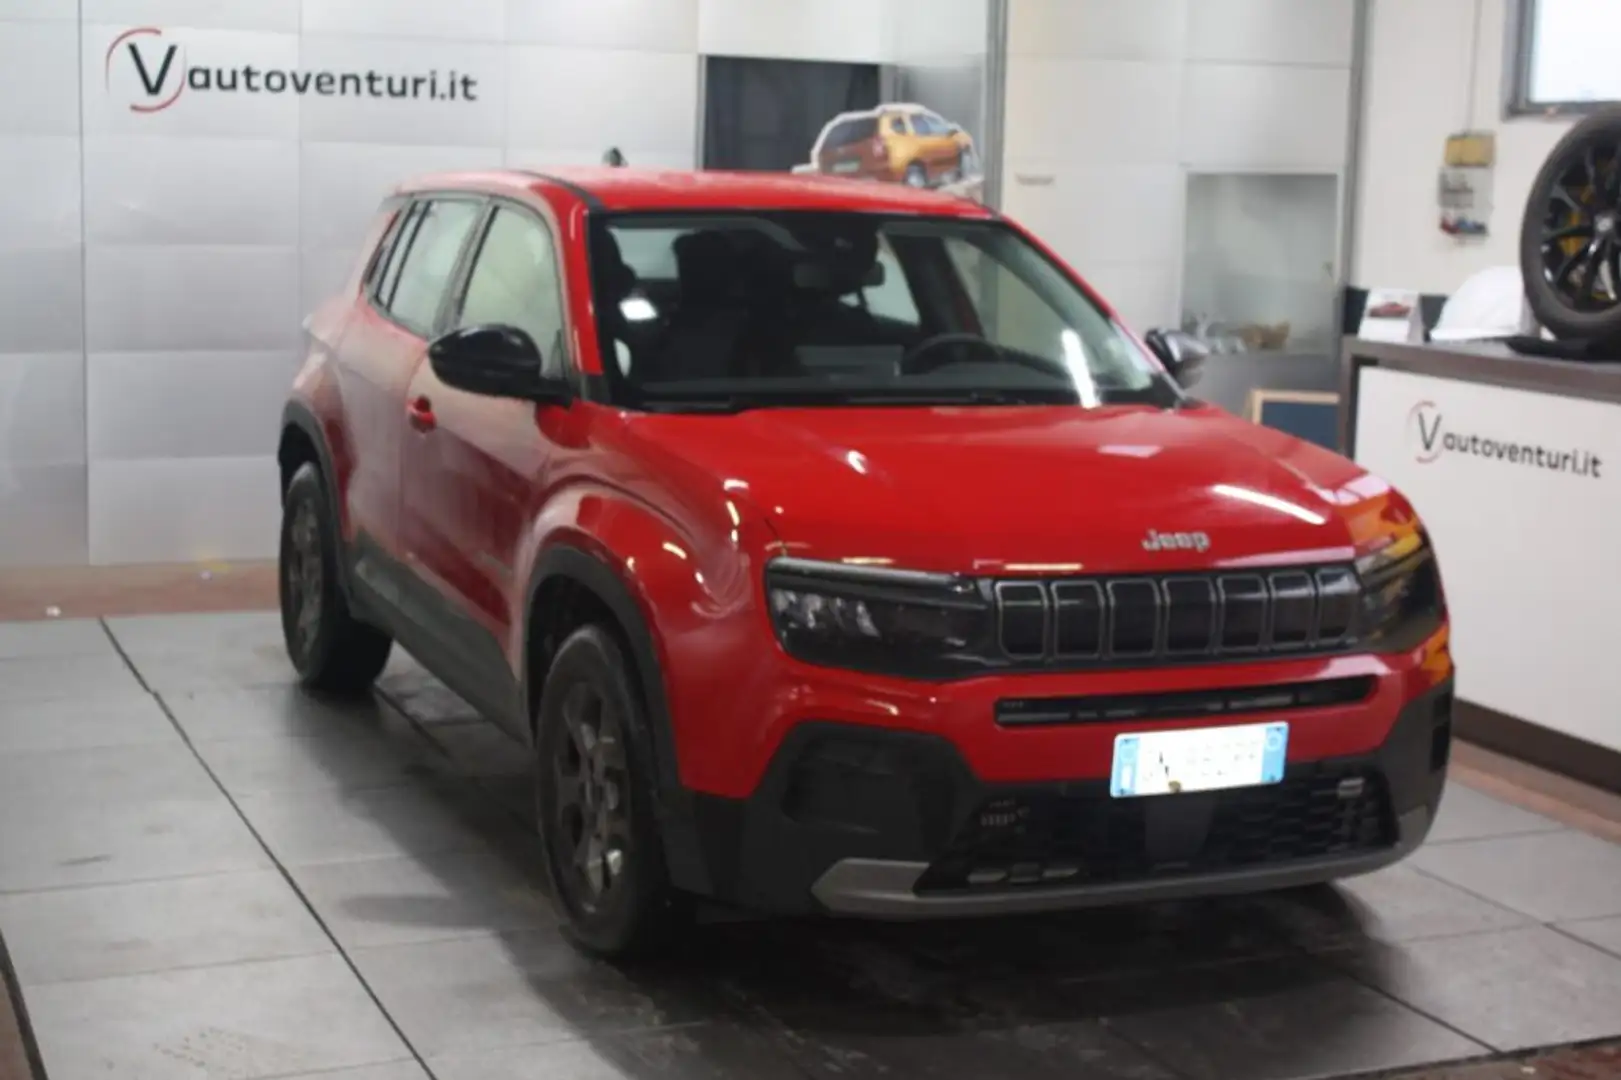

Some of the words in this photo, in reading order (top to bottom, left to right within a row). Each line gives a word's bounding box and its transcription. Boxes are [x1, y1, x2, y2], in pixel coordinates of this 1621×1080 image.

[187, 64, 479, 101] autoventuri.it
[1443, 431, 1602, 478] autoventuri.it
[1141, 528, 1210, 553] Jeep
